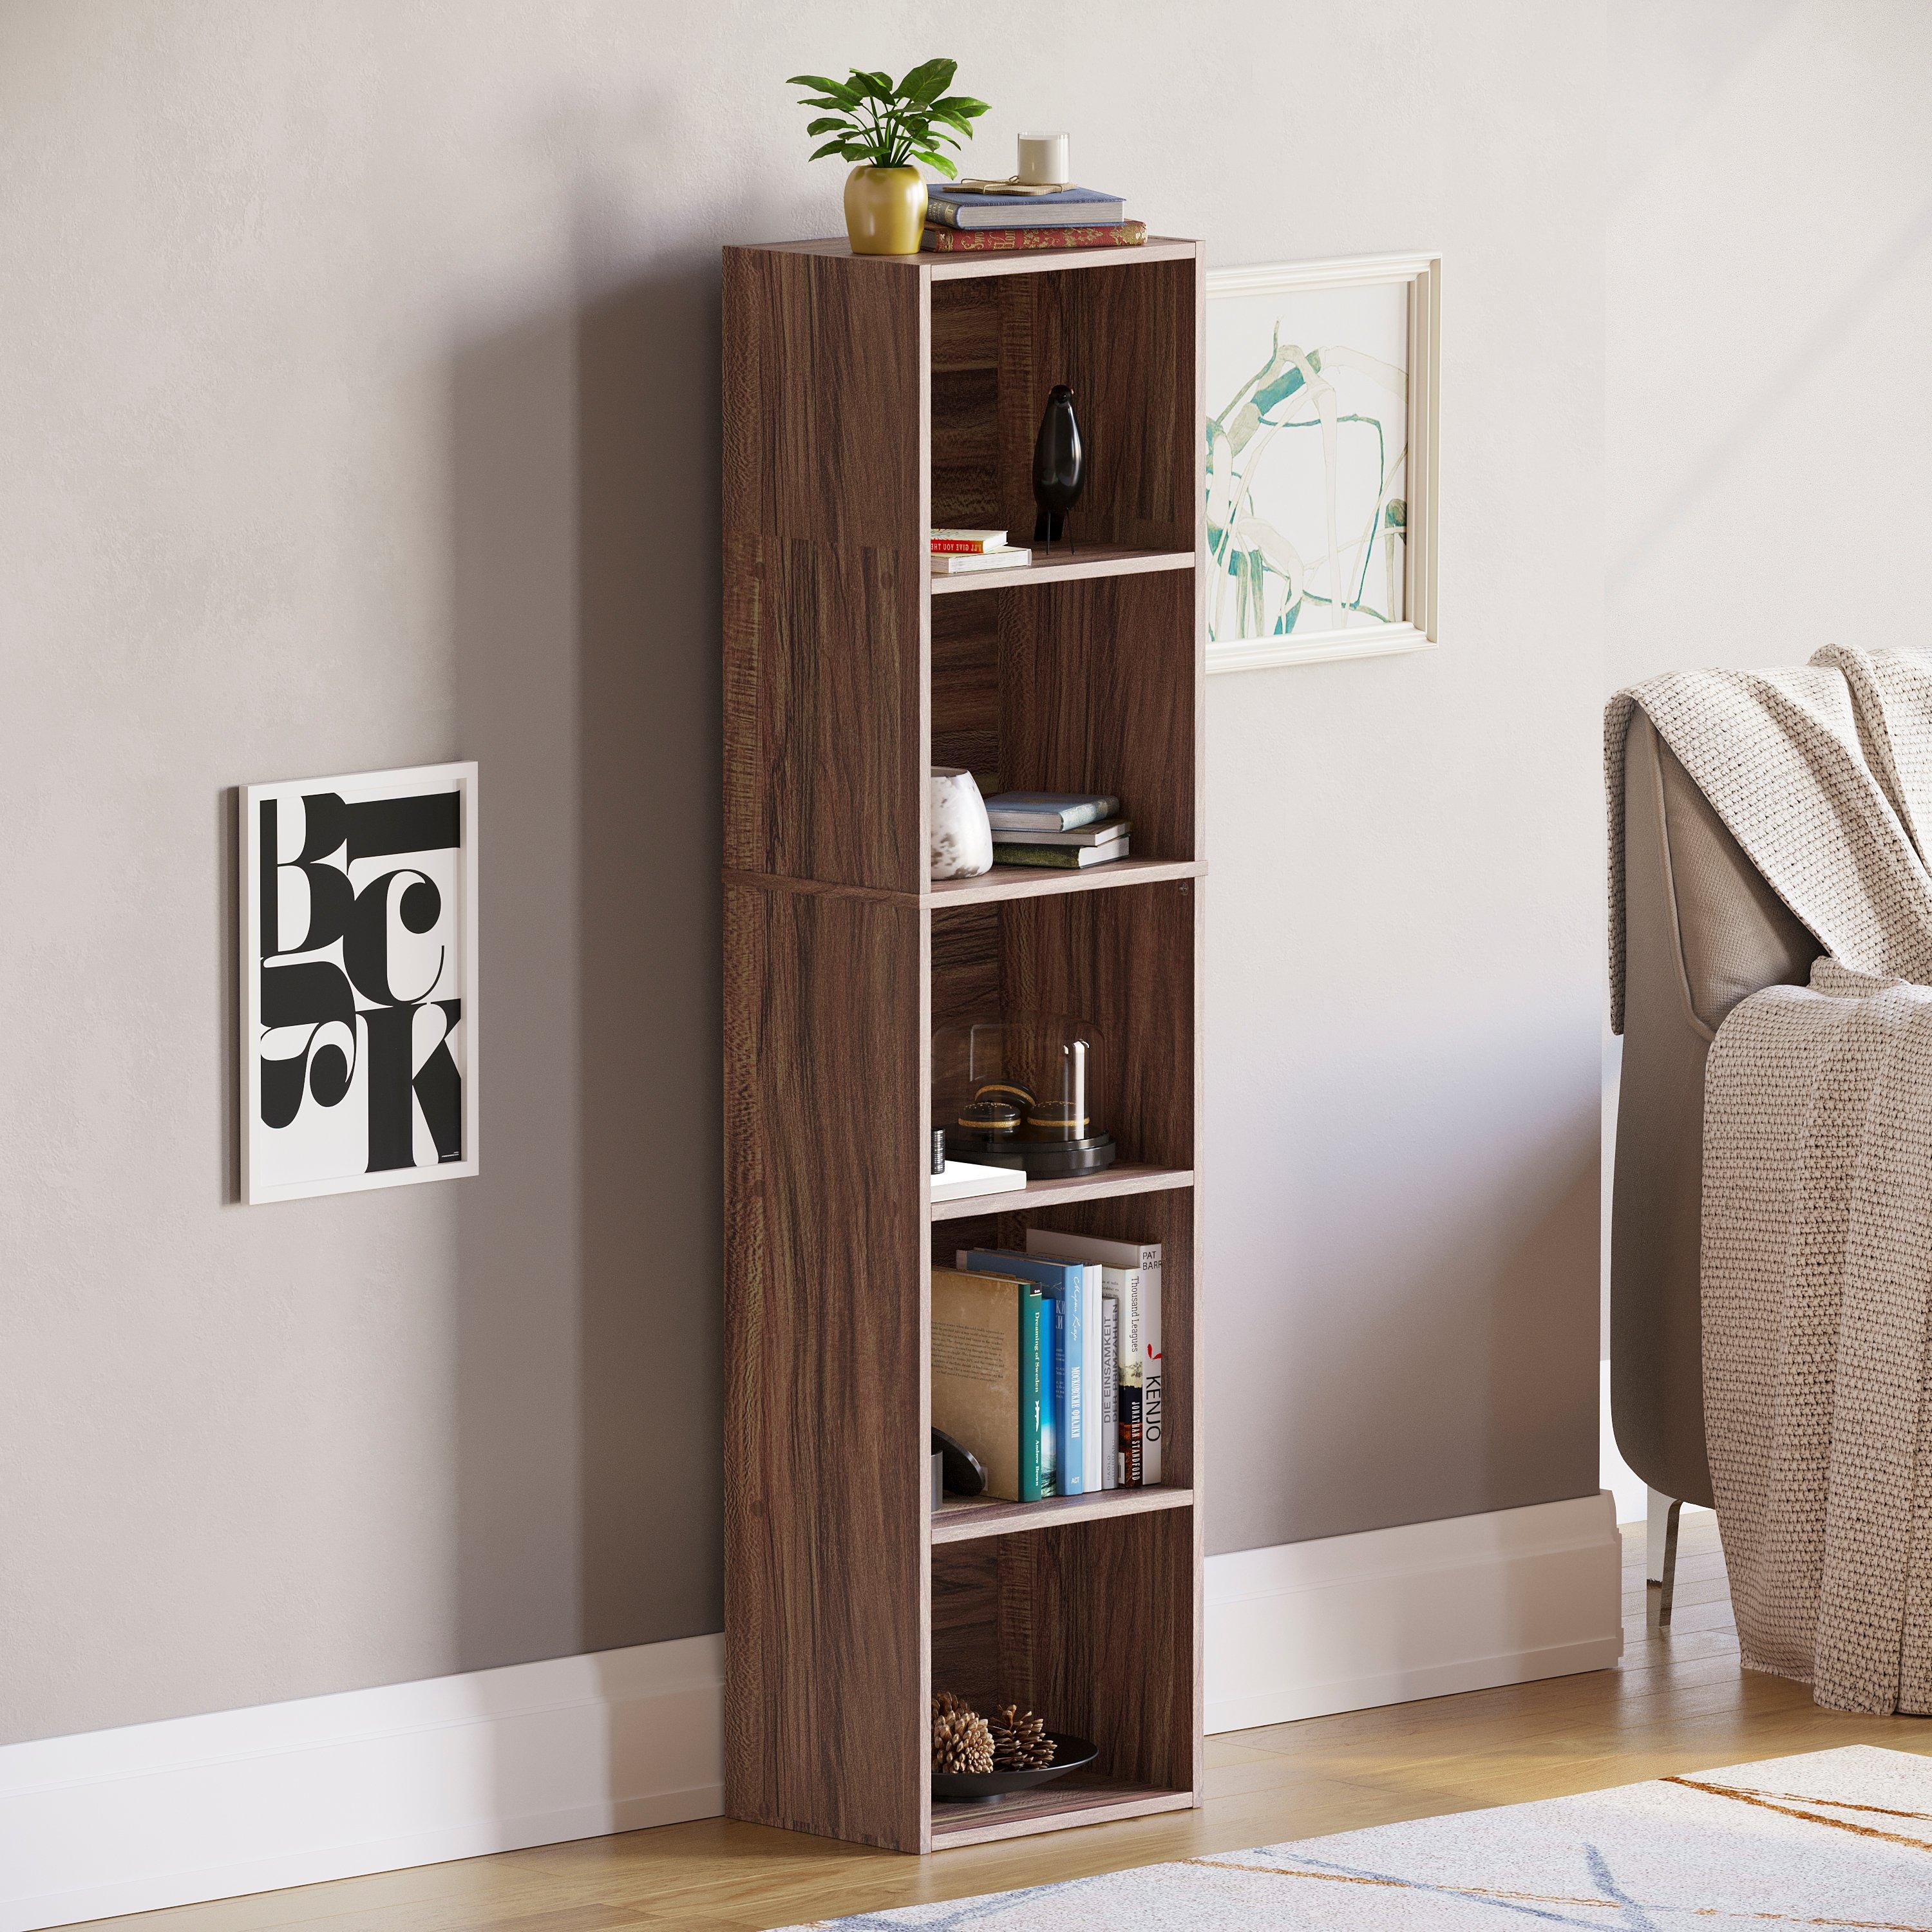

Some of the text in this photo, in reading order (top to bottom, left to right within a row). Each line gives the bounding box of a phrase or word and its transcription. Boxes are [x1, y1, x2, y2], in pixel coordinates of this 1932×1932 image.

[1142, 1251, 1157, 1260] PAT
[1130, 1276, 1140, 1352] Thousand Leagues
[1035, 1352, 1039, 1361] of
[1071, 1366, 1081, 1439] МОСКОВСКИЕ ФИАЛКИ
[1146, 1375, 1161, 1442] KENJO
[1132, 1401, 1141, 1481] JONATHAN STANDFORD
